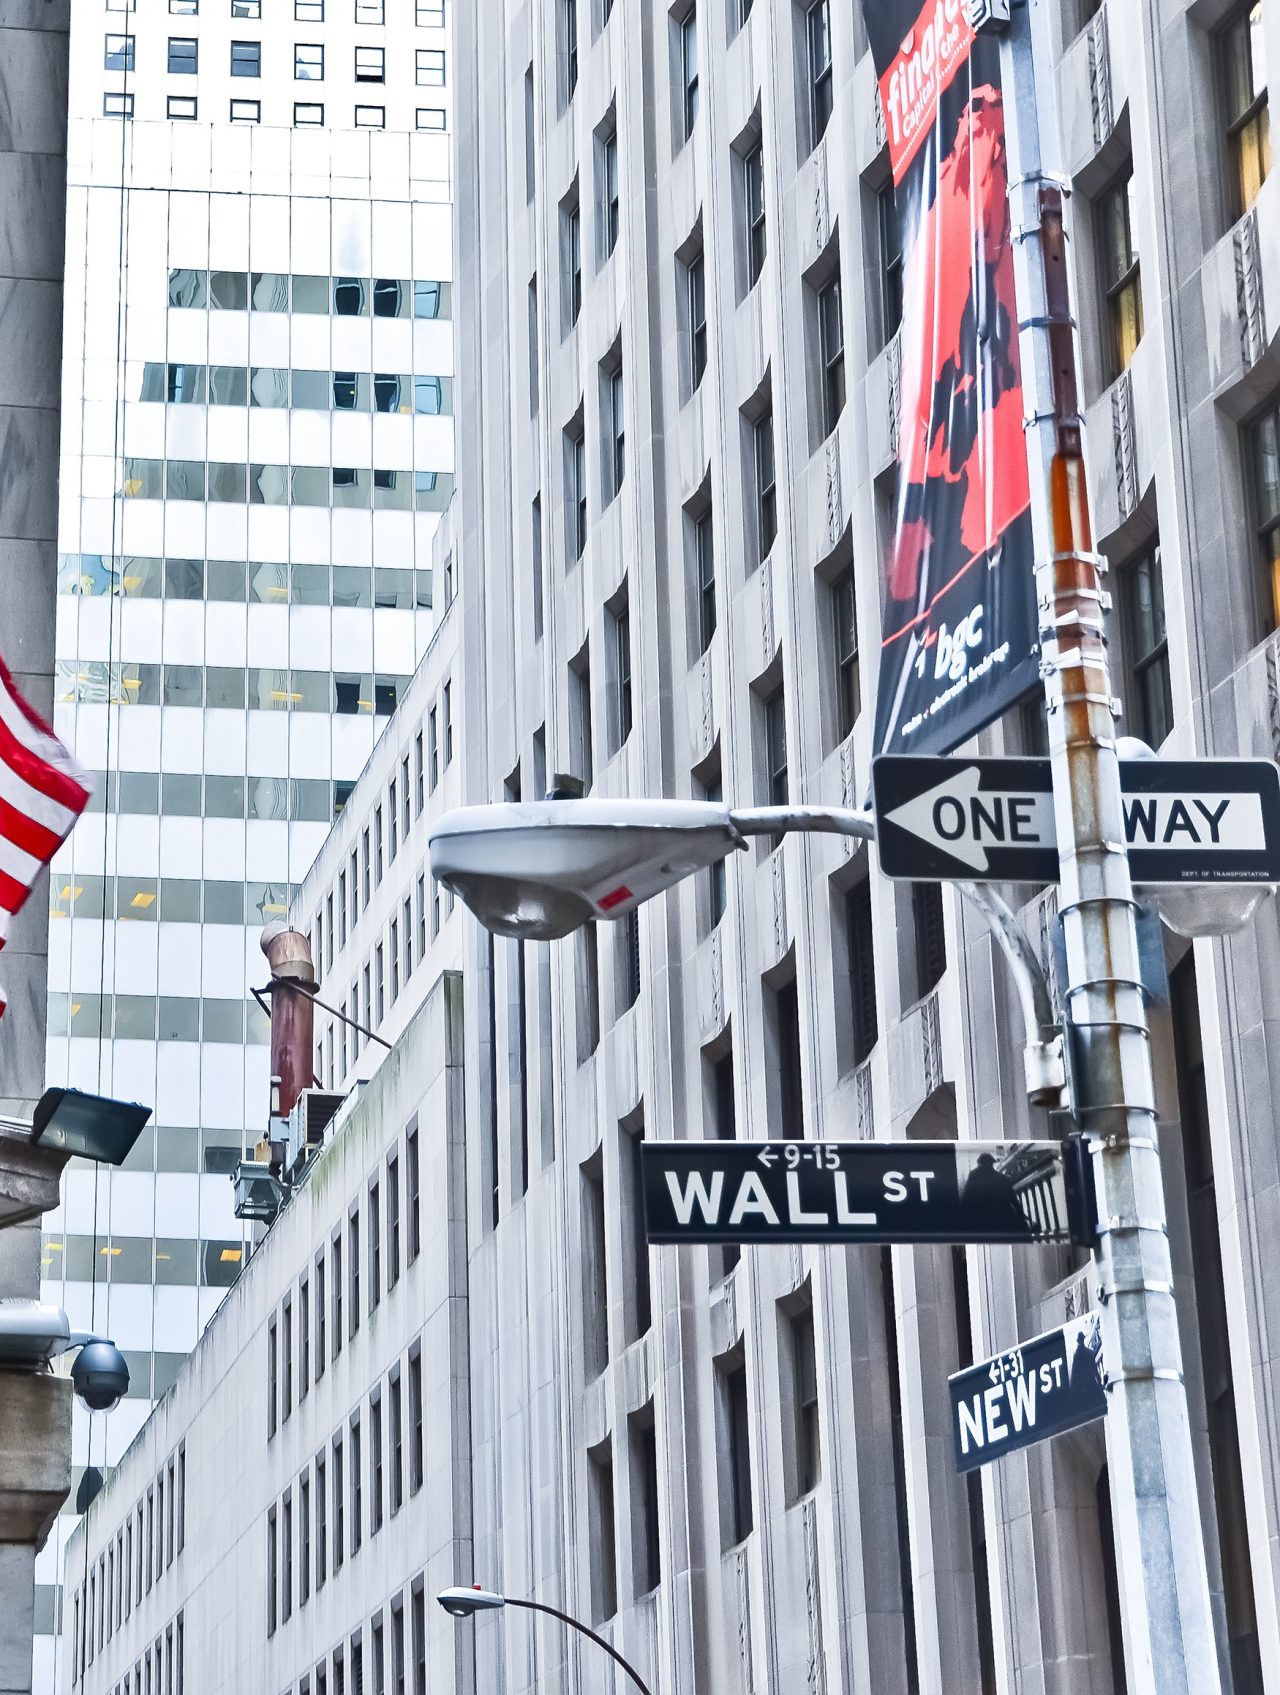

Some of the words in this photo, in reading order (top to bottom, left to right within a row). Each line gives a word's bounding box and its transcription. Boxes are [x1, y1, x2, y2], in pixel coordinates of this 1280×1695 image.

[934, 604, 983, 680] bgc
[932, 795, 1041, 842] ONE
[1122, 799, 1231, 843] WAY
[784, 1144, 841, 1170] 9-15
[664, 1171, 877, 1225] WALL
[882, 1171, 935, 1202] ST
[997, 1350, 1025, 1383] 1-31
[957, 1369, 1037, 1454] NEW
[1039, 1358, 1063, 1394] ST
